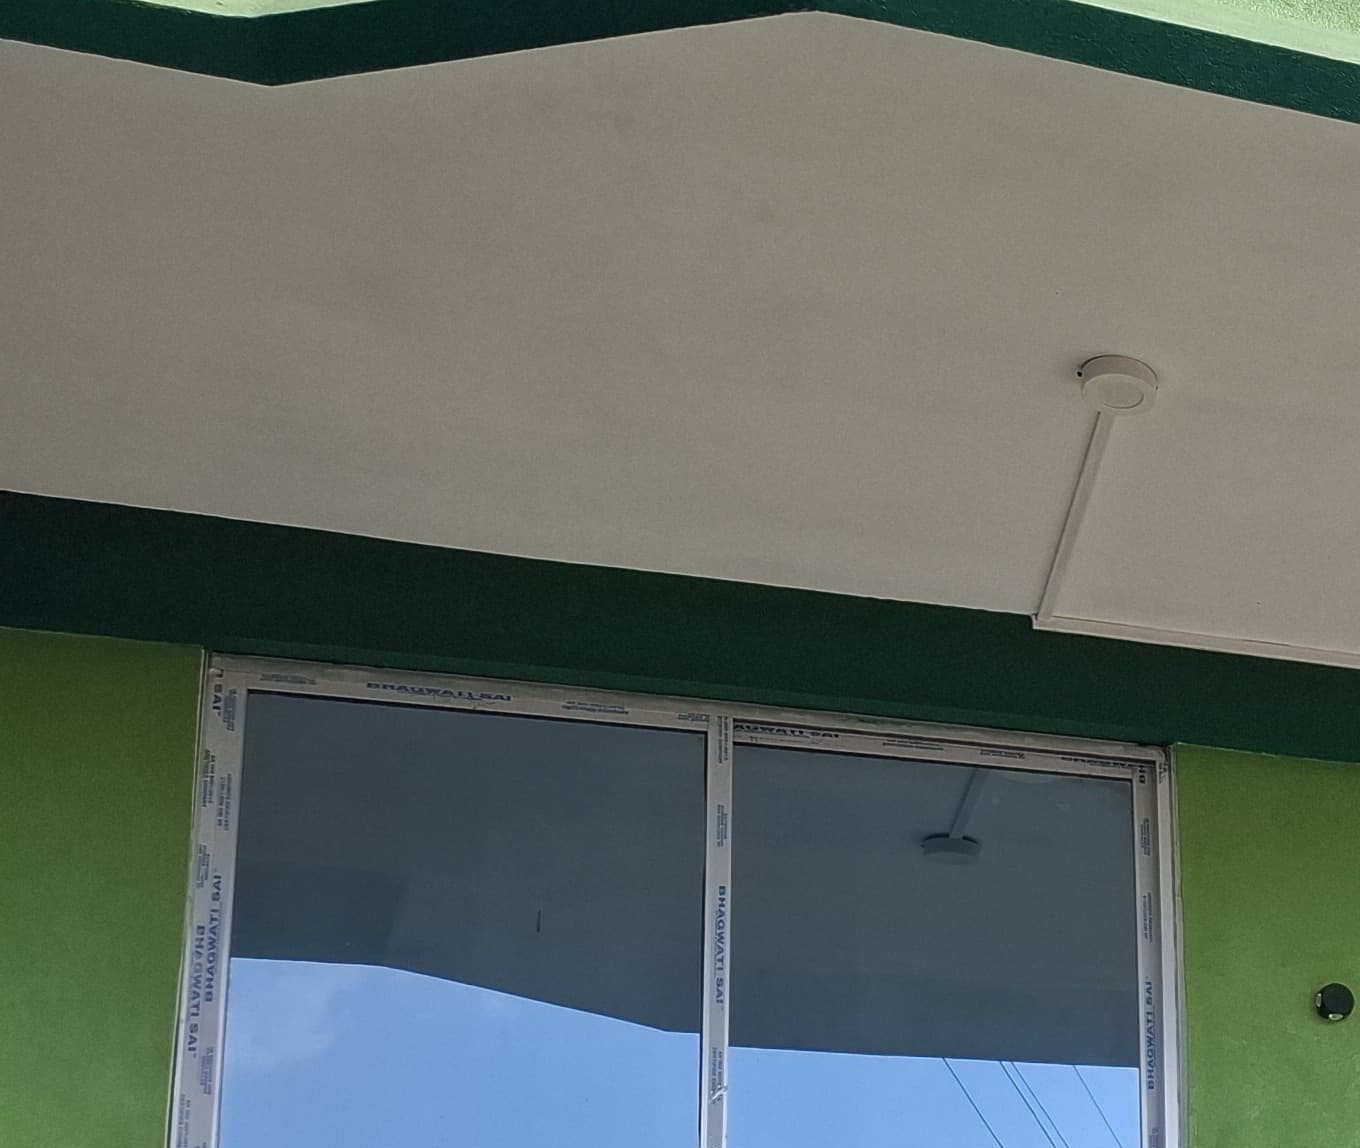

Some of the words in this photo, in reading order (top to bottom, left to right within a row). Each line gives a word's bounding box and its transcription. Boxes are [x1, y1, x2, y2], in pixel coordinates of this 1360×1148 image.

[212, 874, 221, 901] SAI
[717, 885, 726, 971] BHAGWATI
[191, 925, 205, 1017] BHAGWATI
[206, 907, 219, 1001] BHAGWATI
[187, 1023, 198, 1052] SAI
[1146, 1010, 1154, 1089] BHAGWATI
